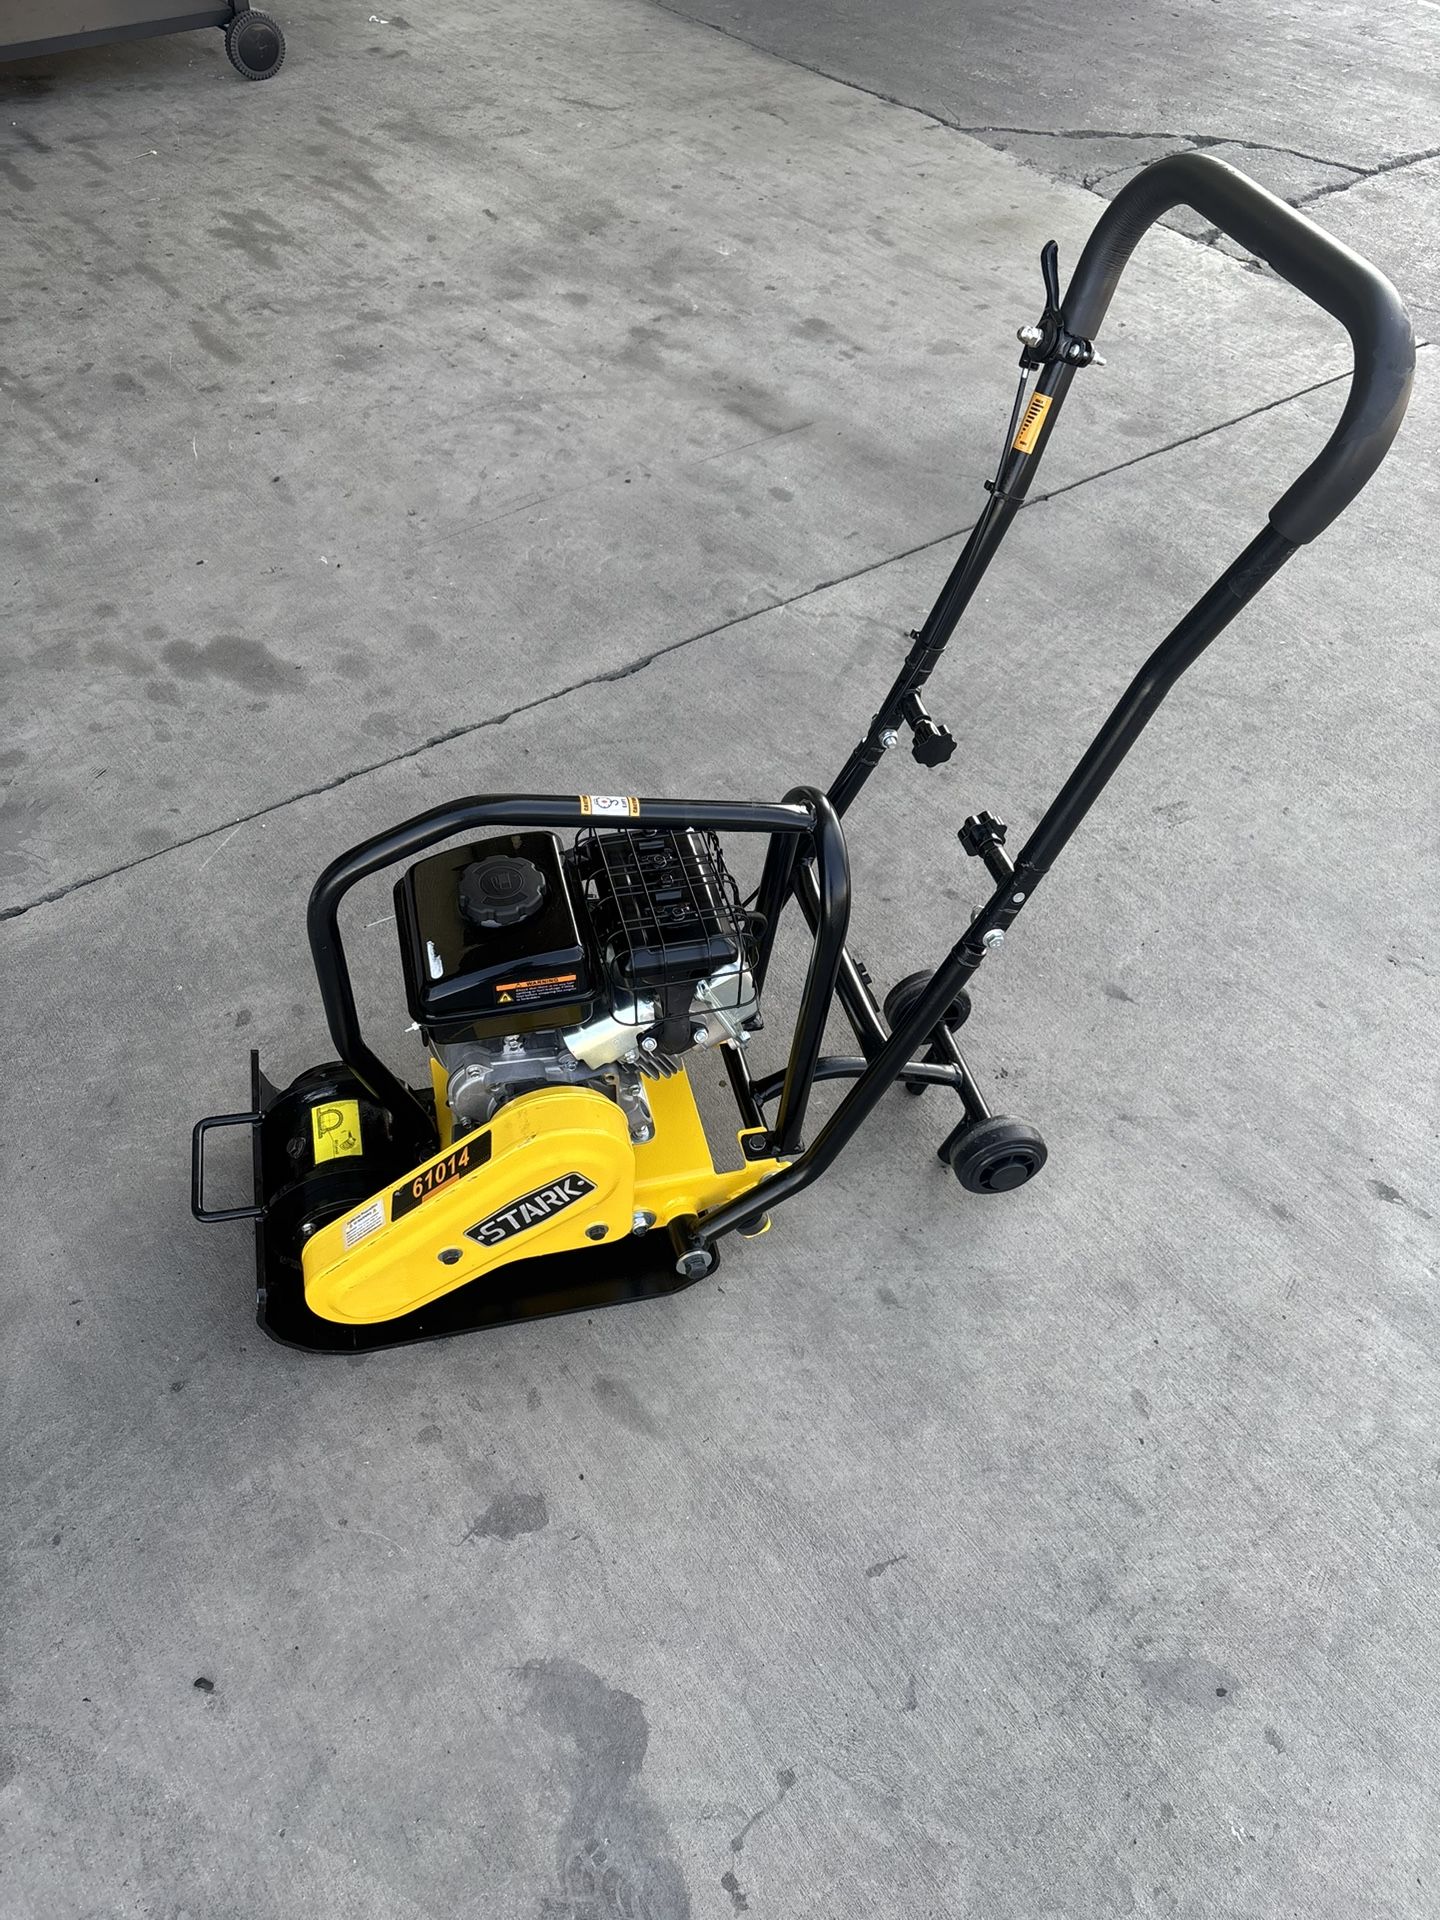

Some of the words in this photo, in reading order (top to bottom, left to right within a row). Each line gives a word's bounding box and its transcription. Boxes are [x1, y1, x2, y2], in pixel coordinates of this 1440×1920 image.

[526, 978, 559, 986] WARNING
[412, 1146, 470, 1198] 61014
[479, 1178, 583, 1243] STARK
